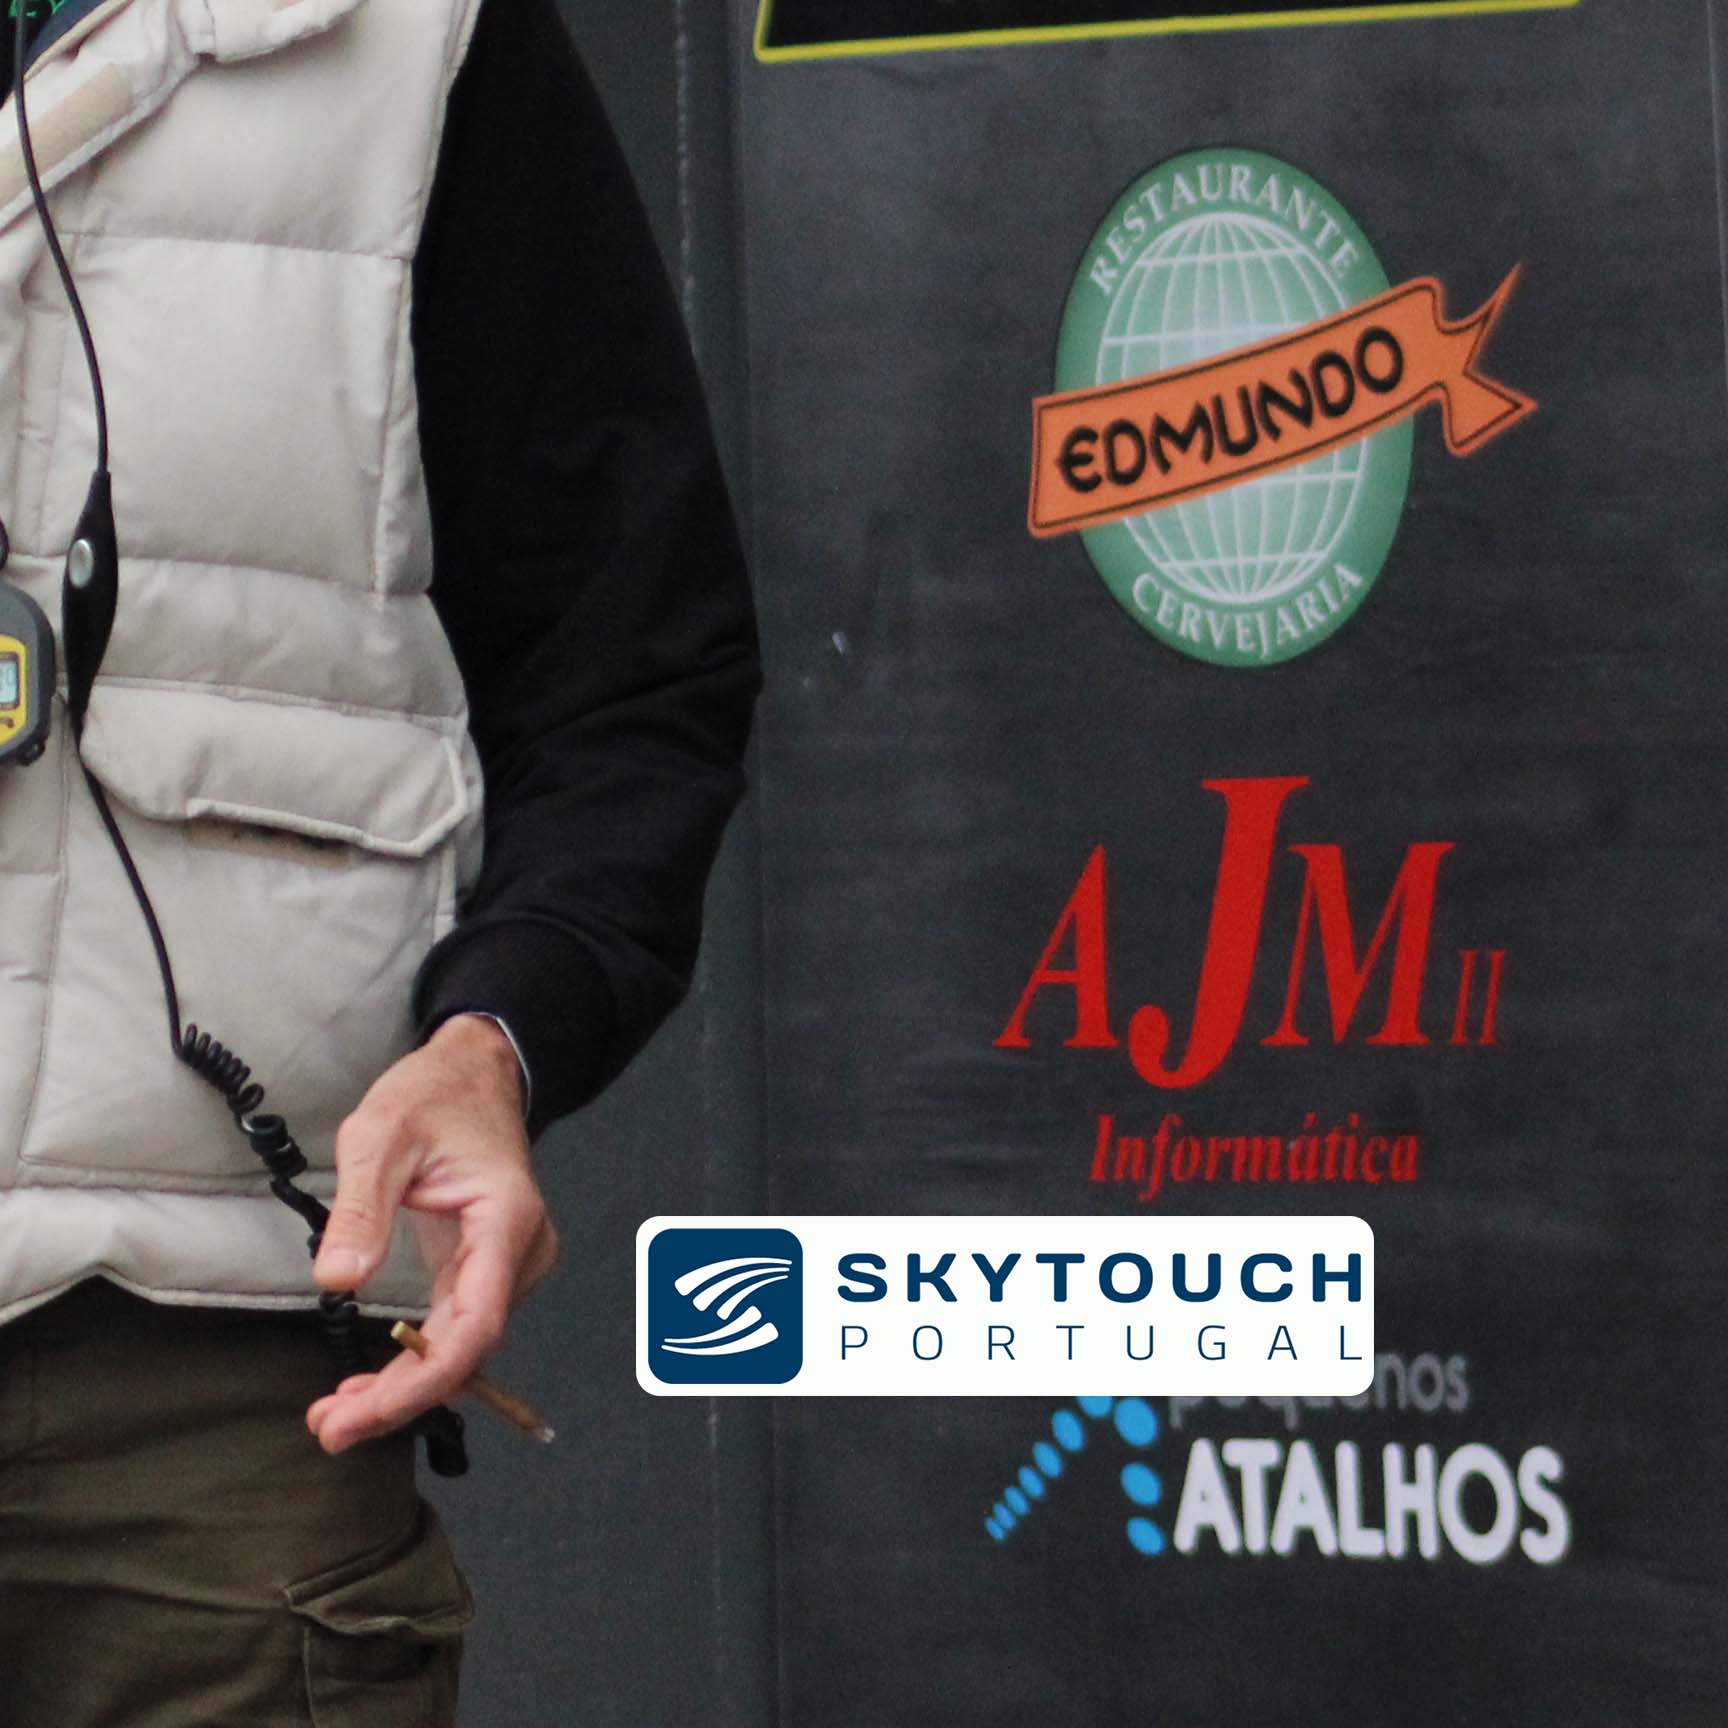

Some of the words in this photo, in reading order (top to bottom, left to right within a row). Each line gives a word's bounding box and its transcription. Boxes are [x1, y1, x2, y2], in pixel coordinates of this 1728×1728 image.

[1089, 162, 1361, 297] RESTAURANTE
[1057, 325, 1405, 493] EDMUNDO
[1131, 560, 1365, 659] CERVEJARIA
[992, 775, 1457, 1090] AJM
[1089, 1111, 1420, 1202] Informática
[1173, 1438, 1571, 1565] ATALHOS
